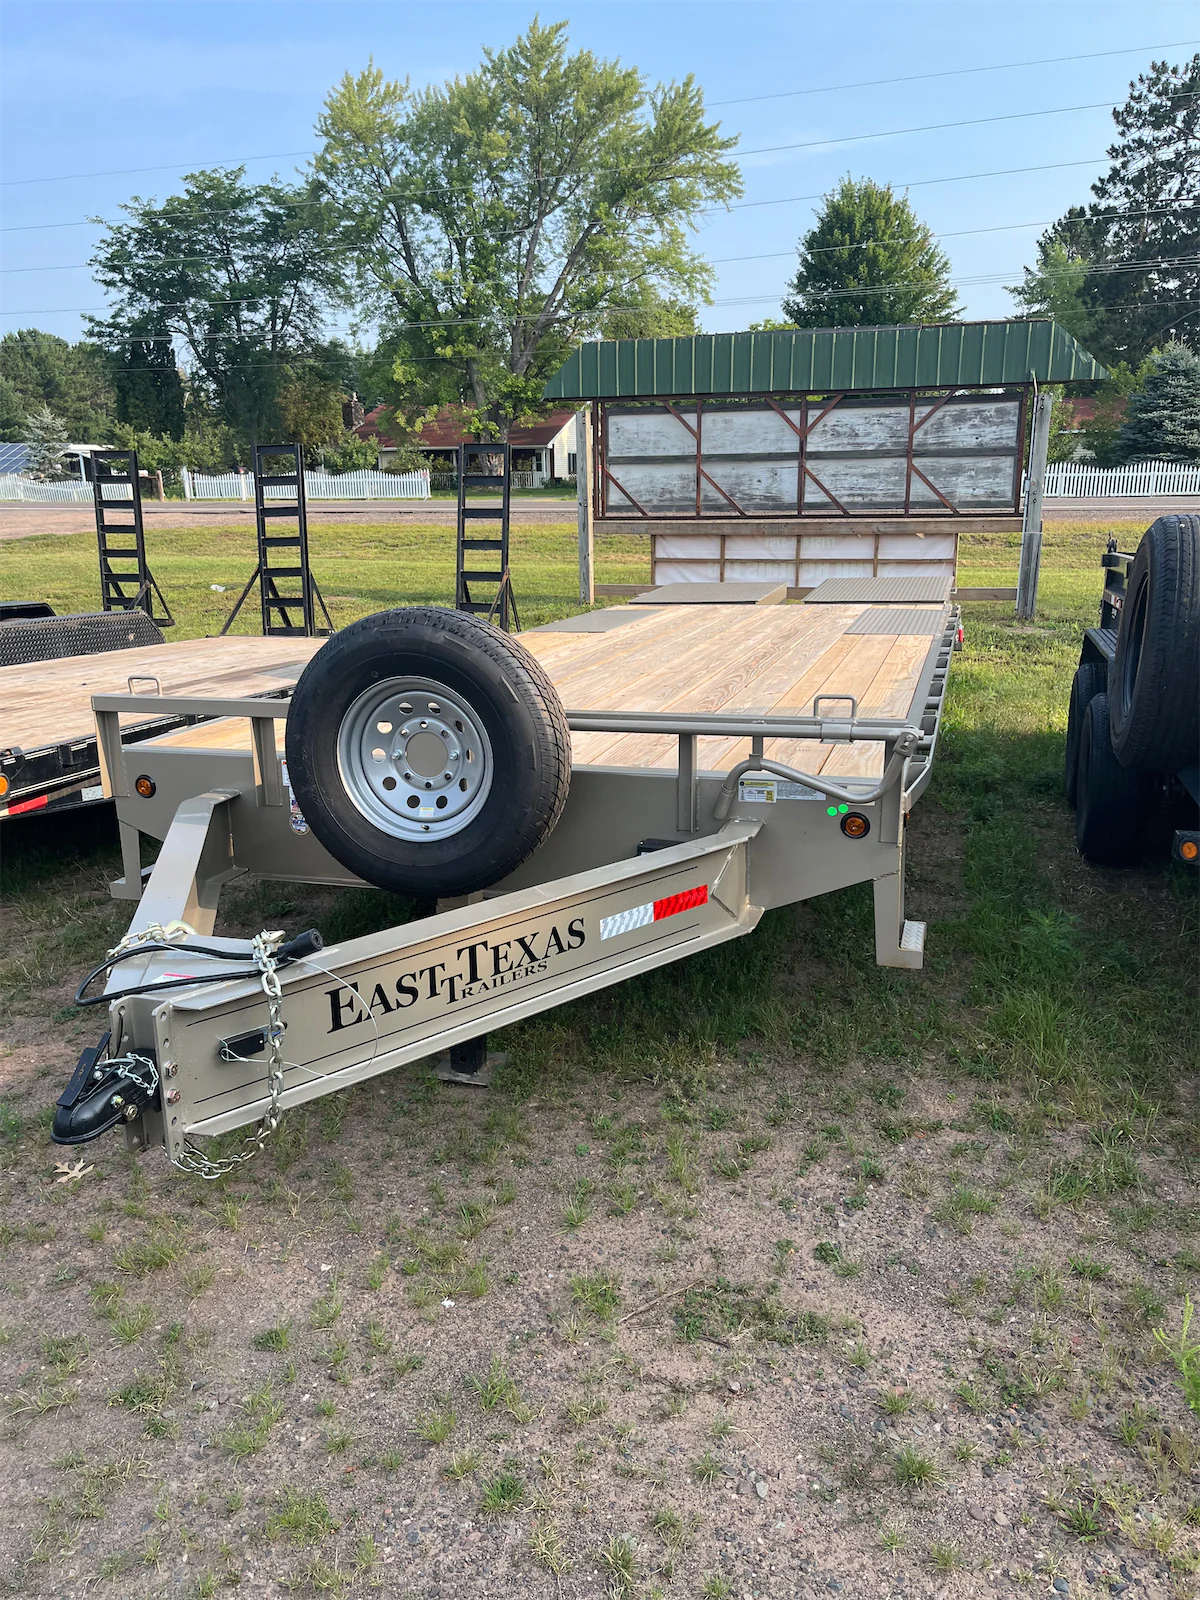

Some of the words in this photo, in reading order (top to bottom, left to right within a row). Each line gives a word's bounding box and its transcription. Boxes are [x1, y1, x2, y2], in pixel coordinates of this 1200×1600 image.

[324, 962, 446, 1034] EAST
[457, 917, 586, 986] TEXAS
[440, 960, 548, 1005] TRAILERS
